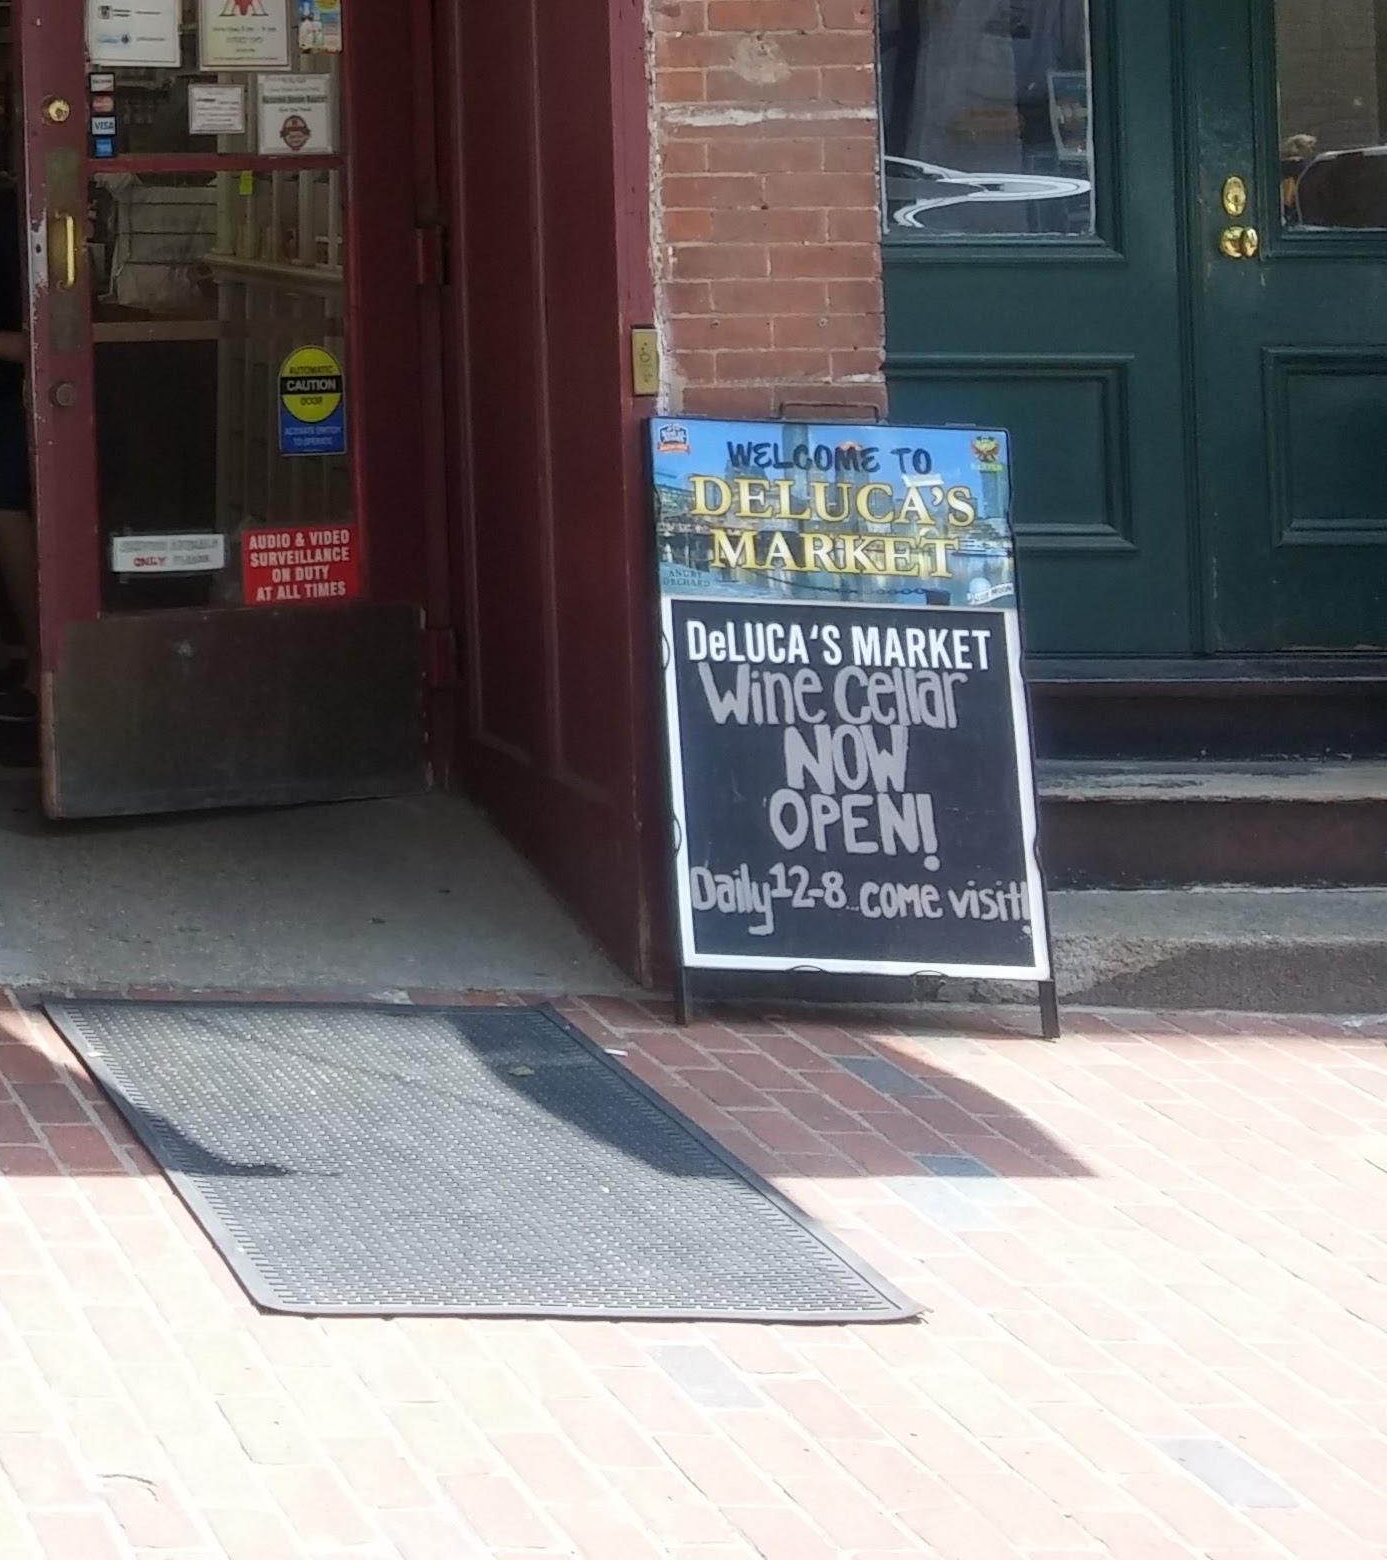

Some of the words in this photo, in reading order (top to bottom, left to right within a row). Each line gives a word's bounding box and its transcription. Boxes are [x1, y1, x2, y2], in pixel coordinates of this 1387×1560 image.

[286, 377, 337, 391] CAUTION
[727, 441, 880, 474] WELCOME
[890, 447, 933, 476] TO
[689, 473, 976, 528] DELUCA'S
[249, 532, 291, 550] AUDIO
[294, 532, 305, 547] &
[309, 529, 350, 546] VIDEO
[250, 546, 350, 568] SURVEILLANCE
[709, 527, 960, 579] MARKET
[132, 556, 168, 567] ONLY
[272, 567, 291, 584] ON
[295, 564, 330, 582] DUTY
[256, 586, 274, 602] AT
[276, 584, 302, 601] ALL
[304, 581, 347, 598] TIMES
[687, 620, 842, 666] DeLUCA'S
[851, 625, 991, 670] MARKET
[698, 662, 827, 725] Wine
[833, 665, 969, 729] Cellar
[784, 724, 909, 794] NOW
[769, 789, 940, 871] OPEN!
[690, 863, 775, 936] Daily
